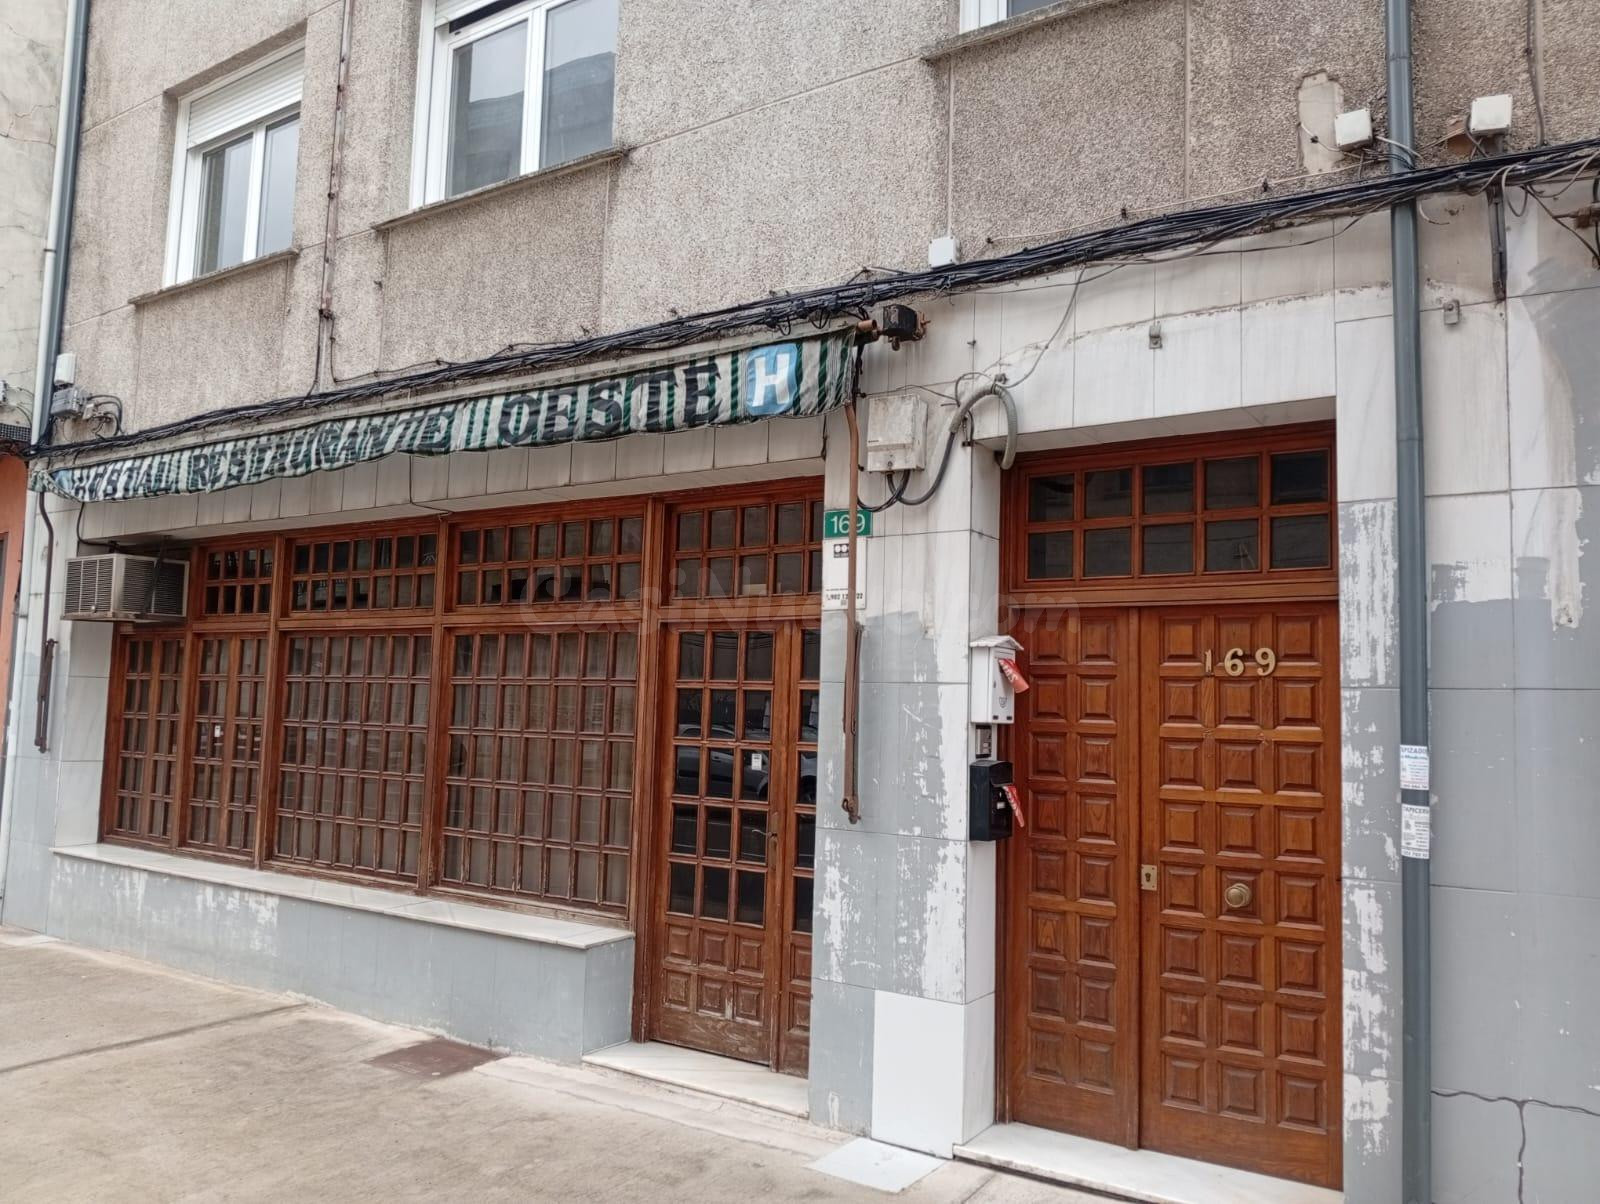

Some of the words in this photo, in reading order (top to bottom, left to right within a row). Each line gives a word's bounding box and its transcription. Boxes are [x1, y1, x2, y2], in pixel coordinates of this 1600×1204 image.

[73, 460, 168, 499] HOSTAL
[190, 409, 450, 489] RESTAURANTE
[499, 361, 721, 445] OESTE
[752, 352, 791, 407] H
[830, 513, 866, 535] 169
[1205, 647, 1276, 676] 169
